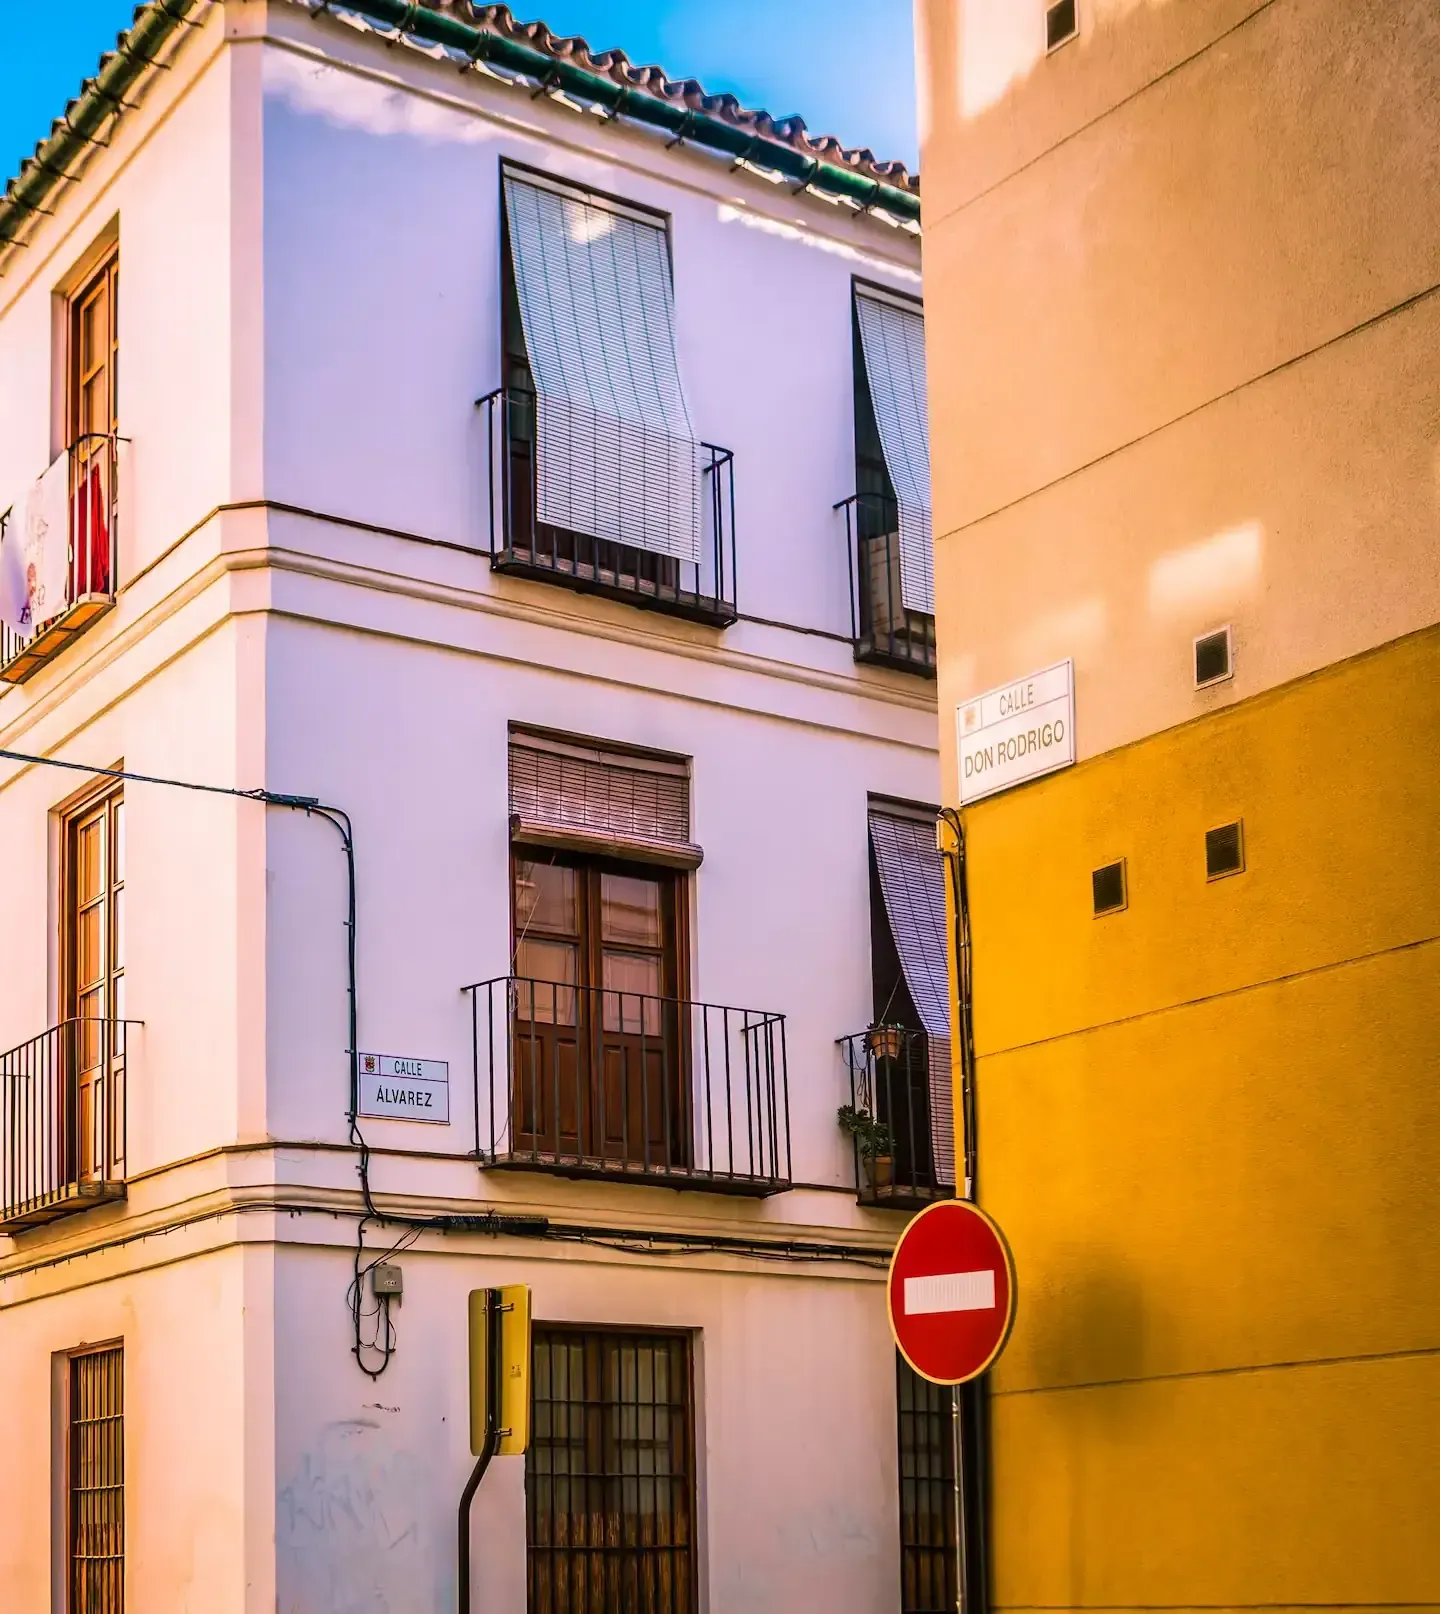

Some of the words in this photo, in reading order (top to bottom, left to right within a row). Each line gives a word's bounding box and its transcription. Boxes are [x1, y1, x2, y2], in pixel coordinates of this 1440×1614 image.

[999, 684, 1034, 716] CALLE
[965, 746, 993, 778] DON
[997, 720, 1064, 765] RODRIGO
[394, 1060, 422, 1076] CALLE
[376, 1085, 432, 1107] ÁLVAREZ
